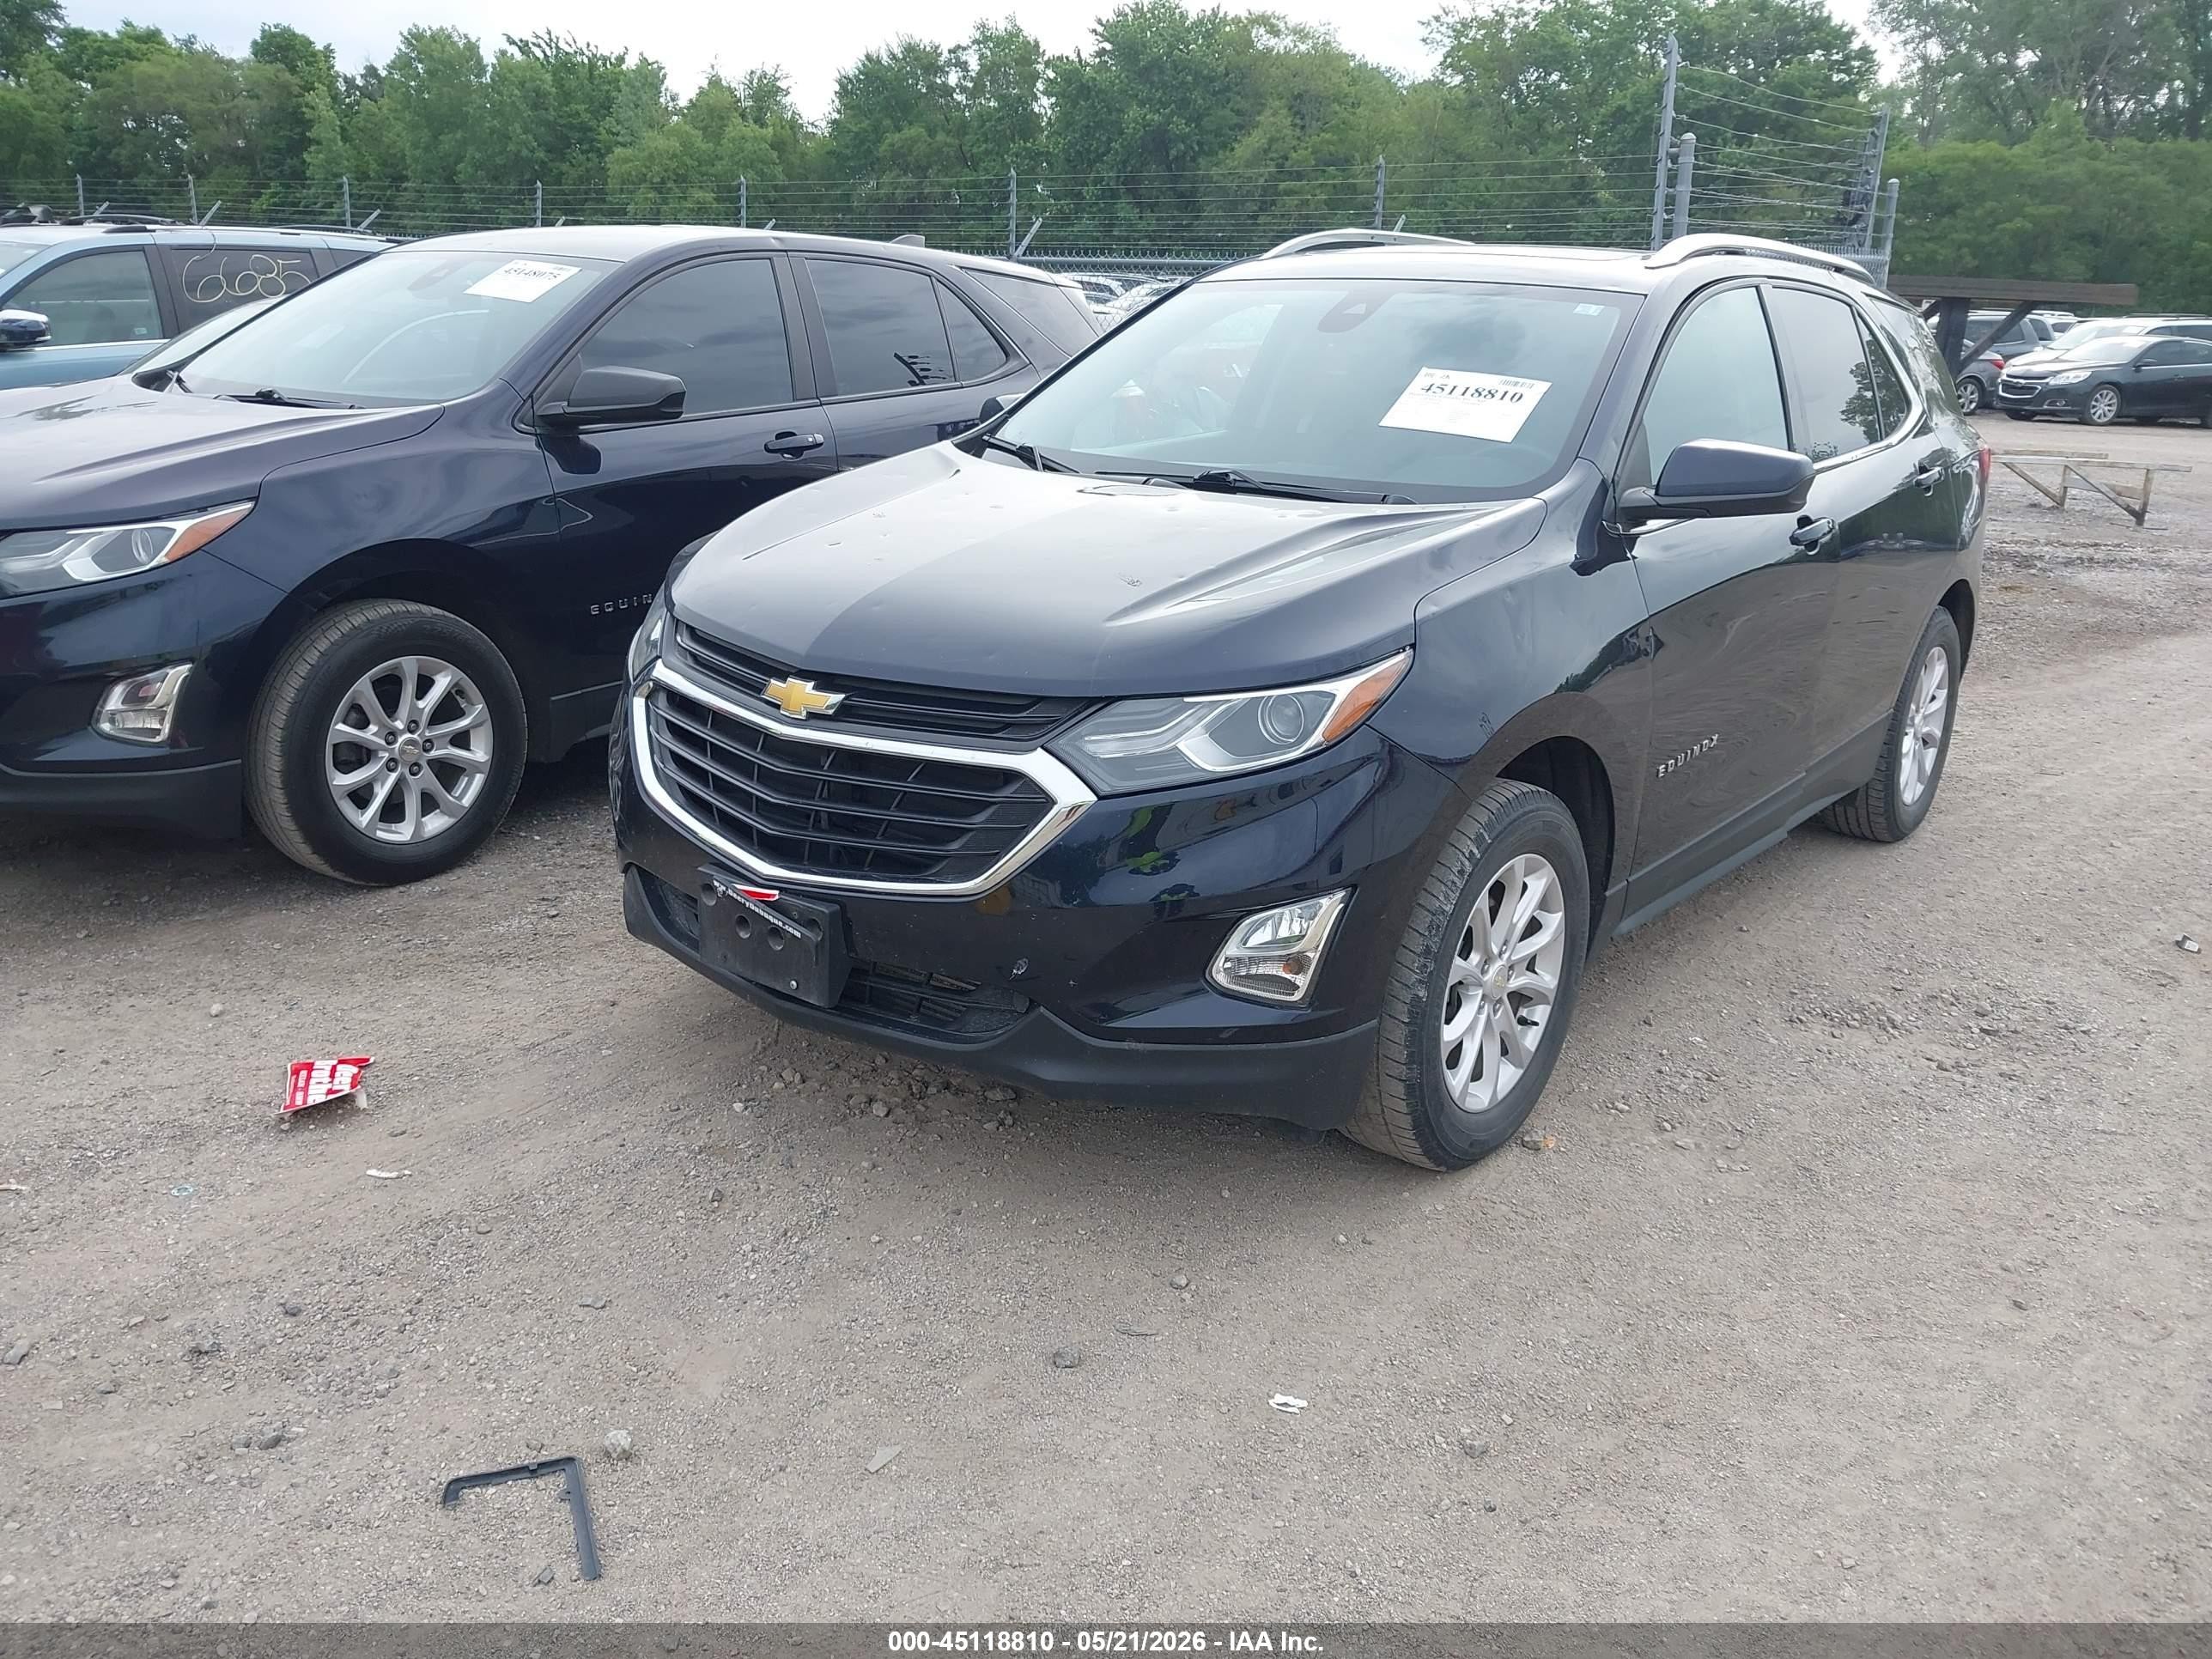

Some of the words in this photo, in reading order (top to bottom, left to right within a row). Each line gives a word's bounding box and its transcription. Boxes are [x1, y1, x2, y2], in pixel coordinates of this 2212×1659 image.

[183, 240, 311, 303] 6685
[1421, 383, 1523, 403] 45118810
[1656, 733, 1720, 778] EQUINOX
